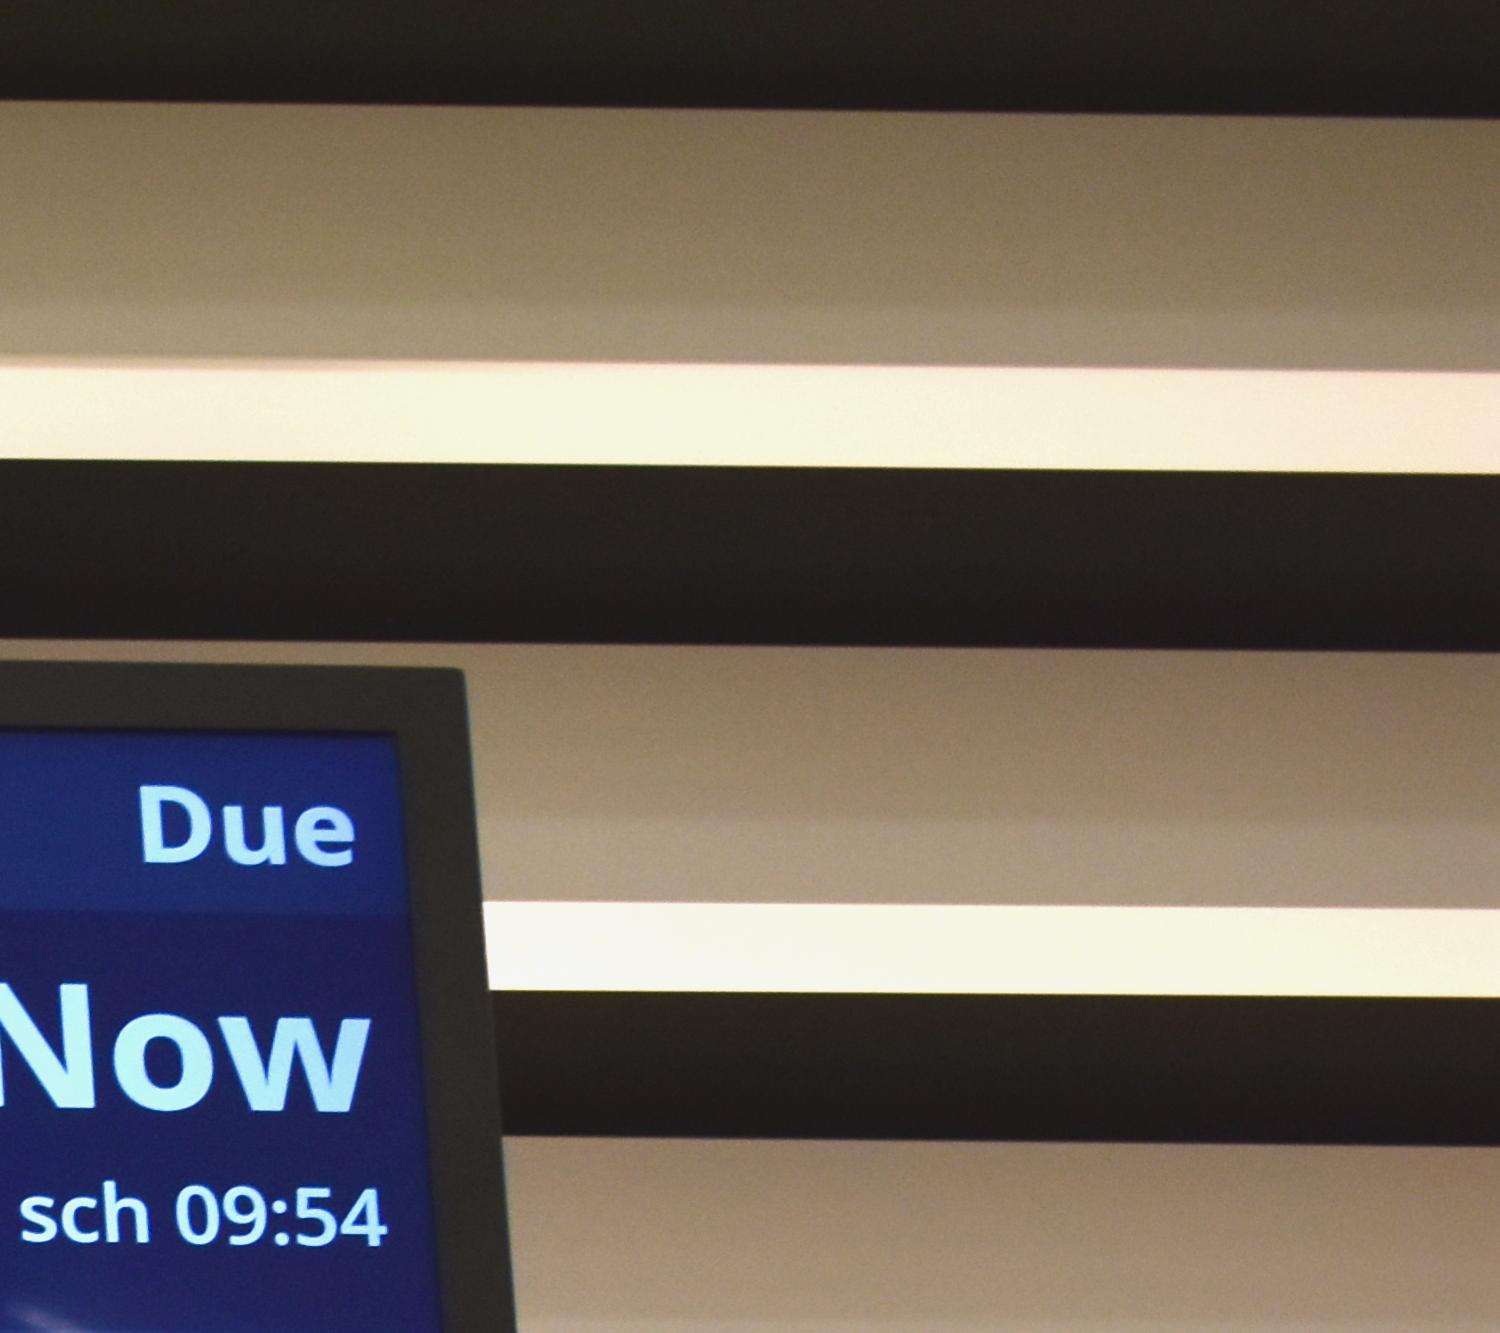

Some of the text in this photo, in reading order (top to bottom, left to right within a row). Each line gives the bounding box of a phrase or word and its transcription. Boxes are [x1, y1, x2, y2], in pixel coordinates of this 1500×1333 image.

[138, 784, 356, 868] Due
[19, 1179, 389, 1248] sch 09:54
